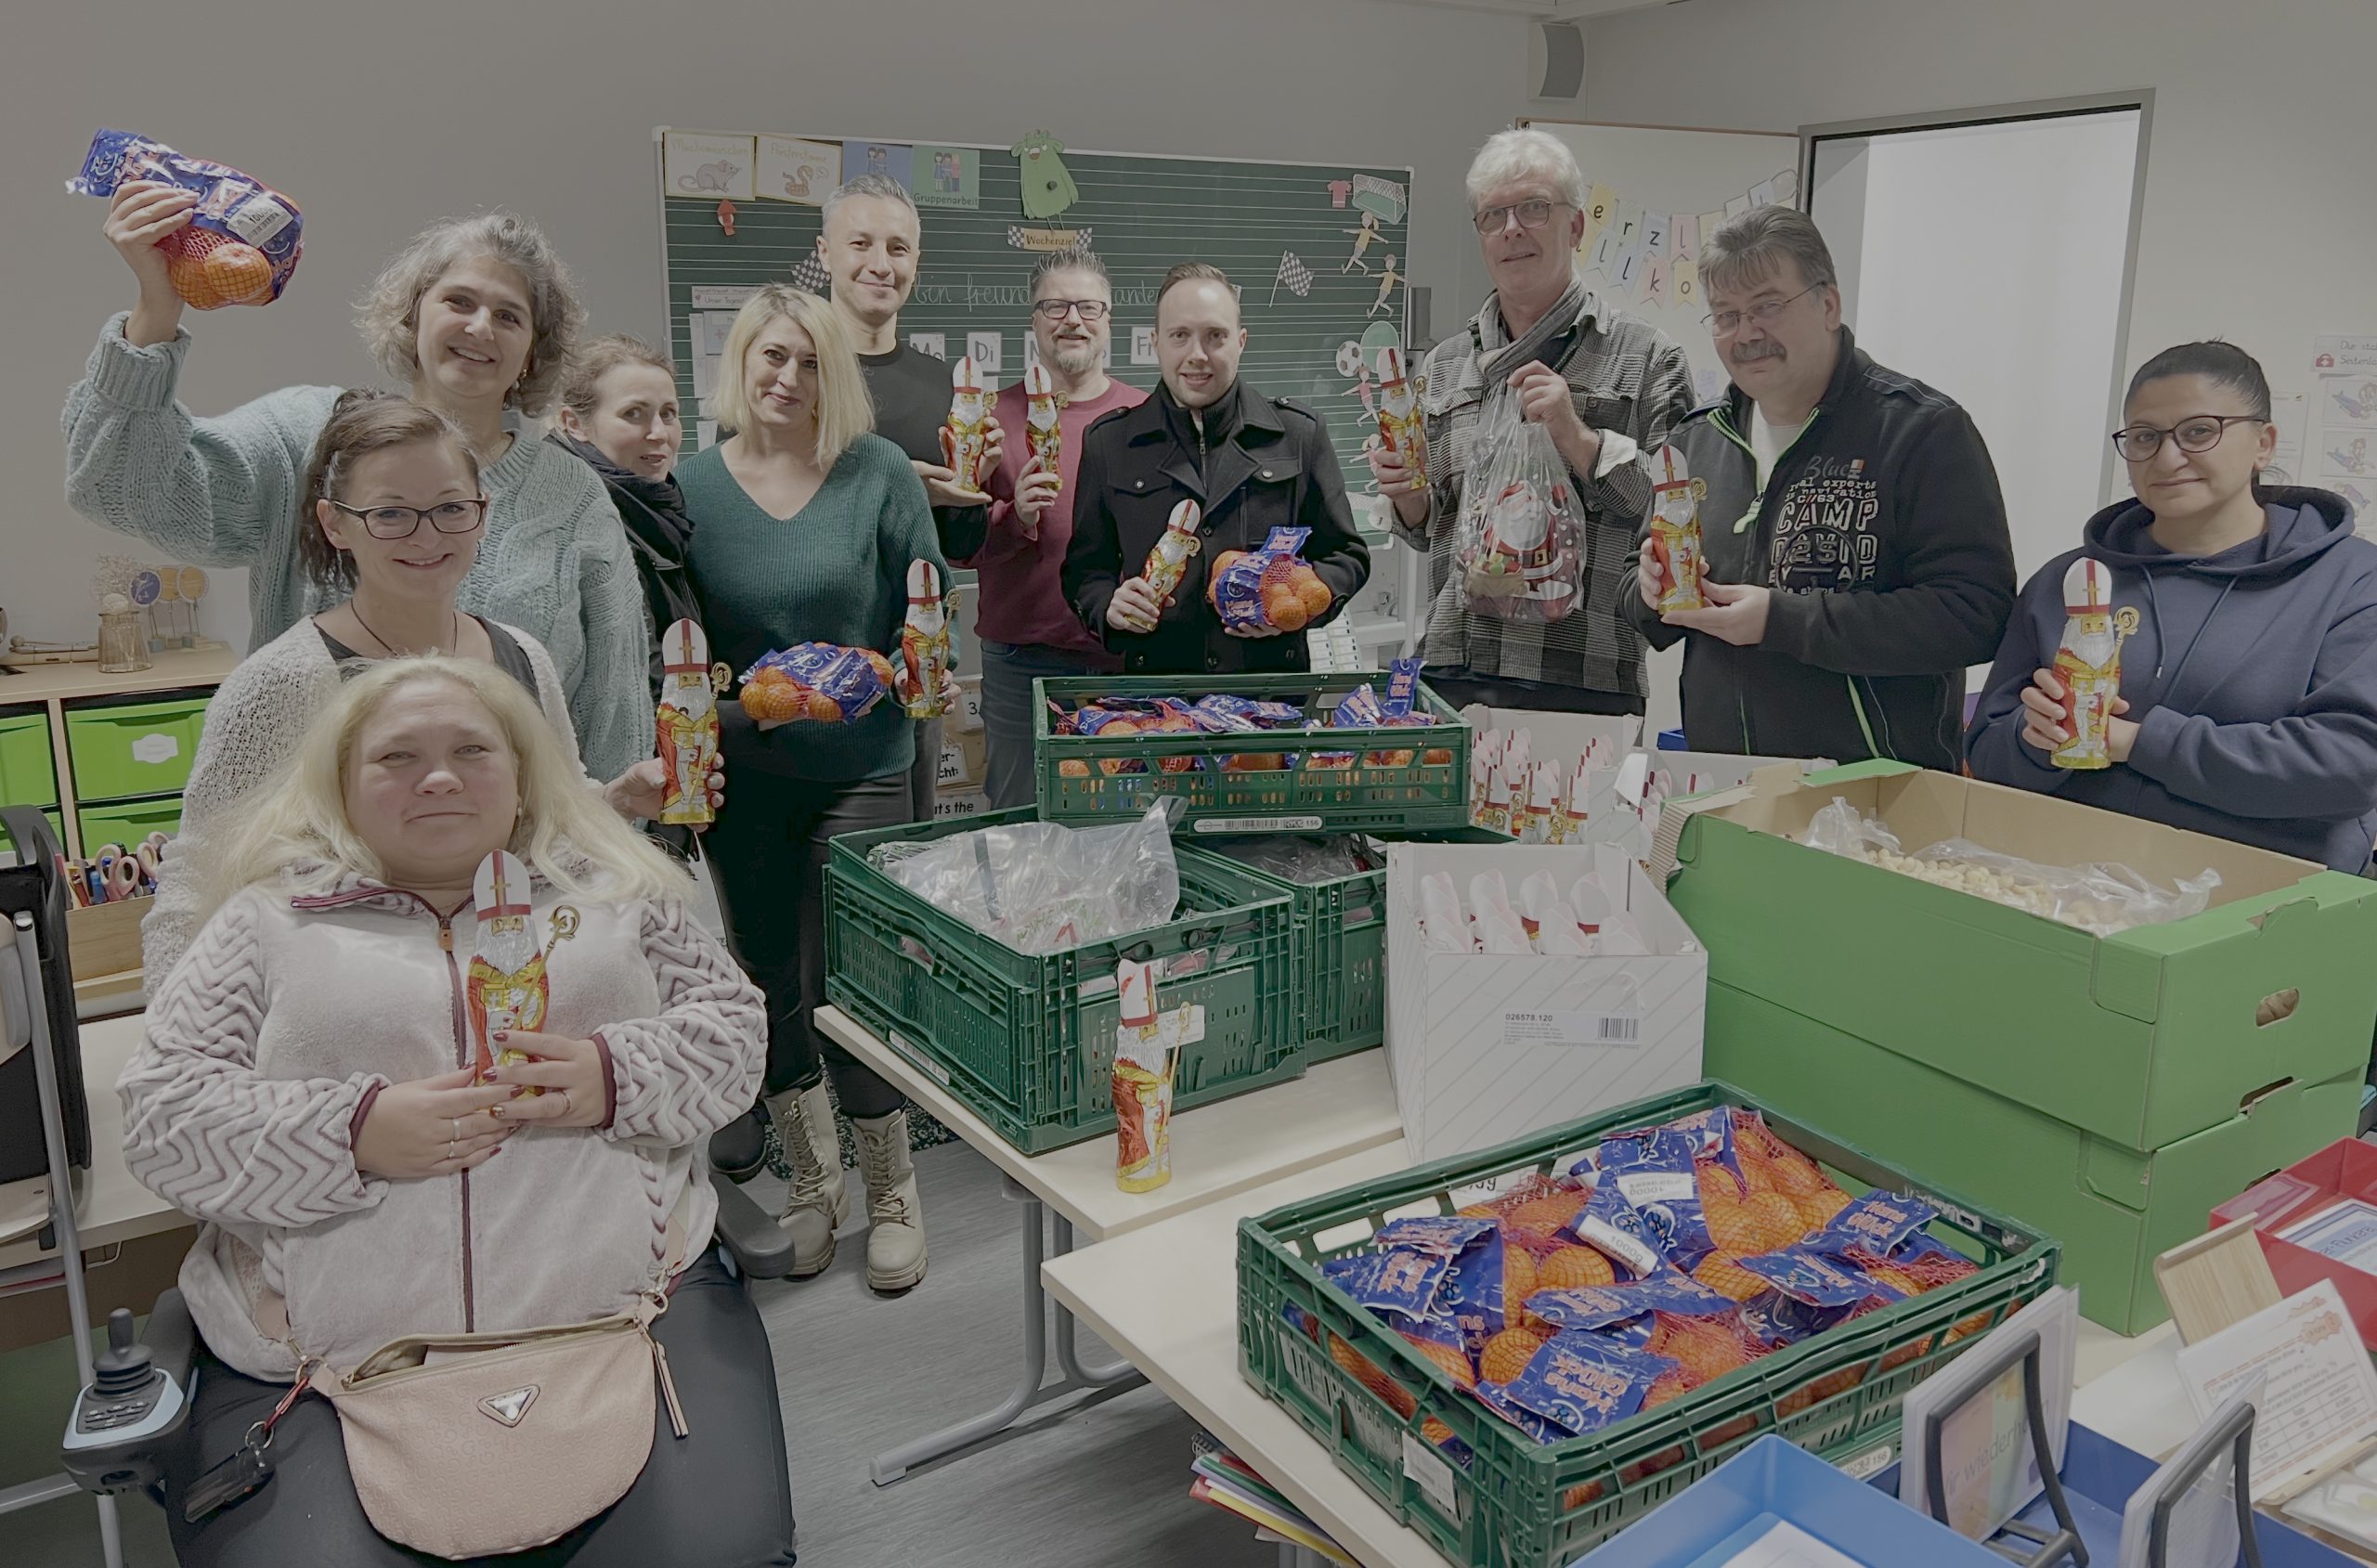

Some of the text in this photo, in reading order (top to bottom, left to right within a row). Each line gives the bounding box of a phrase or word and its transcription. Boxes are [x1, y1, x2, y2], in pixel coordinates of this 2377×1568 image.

[913, 193, 979, 207] Gruppenarbeit
[1026, 235, 1076, 247] Wochenziel
[915, 272, 954, 305] bin
[975, 340, 994, 363] Di
[1823, 479, 1877, 492] experts
[1775, 498, 1879, 535] CAMP
[954, 801, 974, 813] the
[1610, 1234, 1643, 1264] 1000g
[1552, 1354, 1628, 1398] Glück
[1544, 1371, 1614, 1414] Hans
